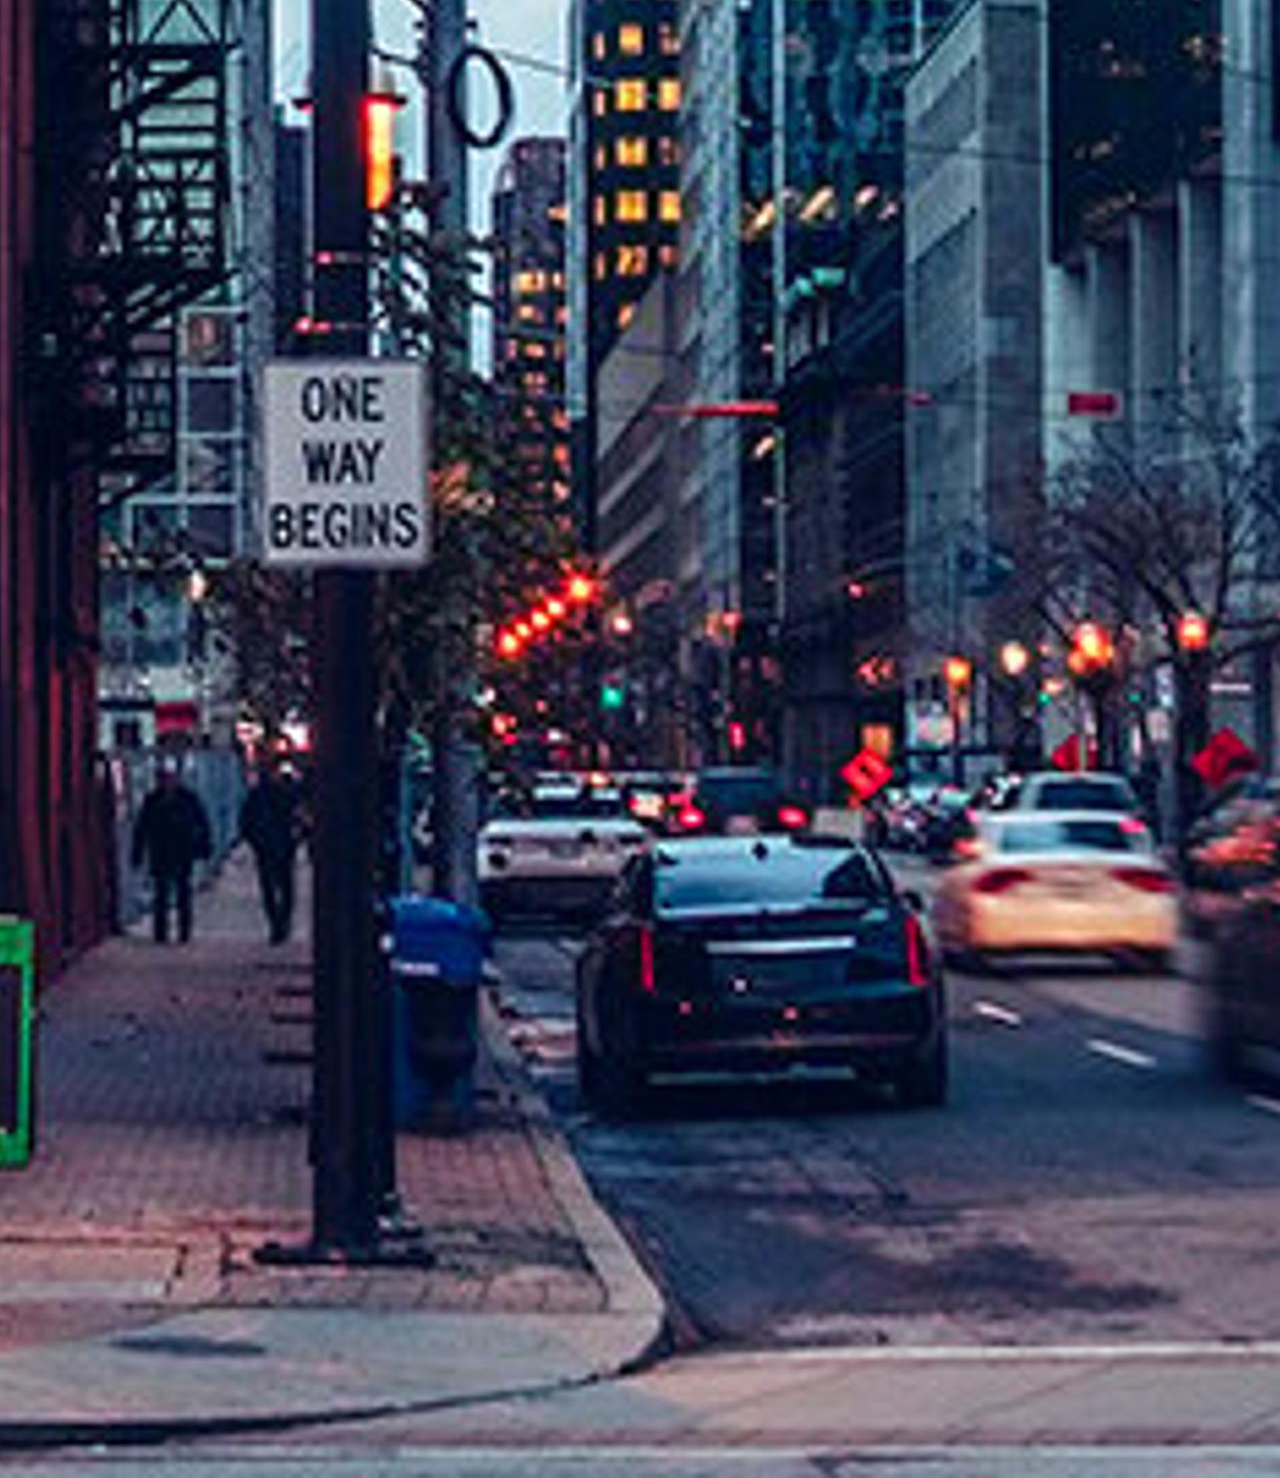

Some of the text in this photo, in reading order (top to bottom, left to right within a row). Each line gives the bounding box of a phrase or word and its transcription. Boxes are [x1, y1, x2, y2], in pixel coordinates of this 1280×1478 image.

[301, 376, 385, 424] ONE
[301, 437, 385, 485] WAY
[269, 501, 419, 550] BEGINS
